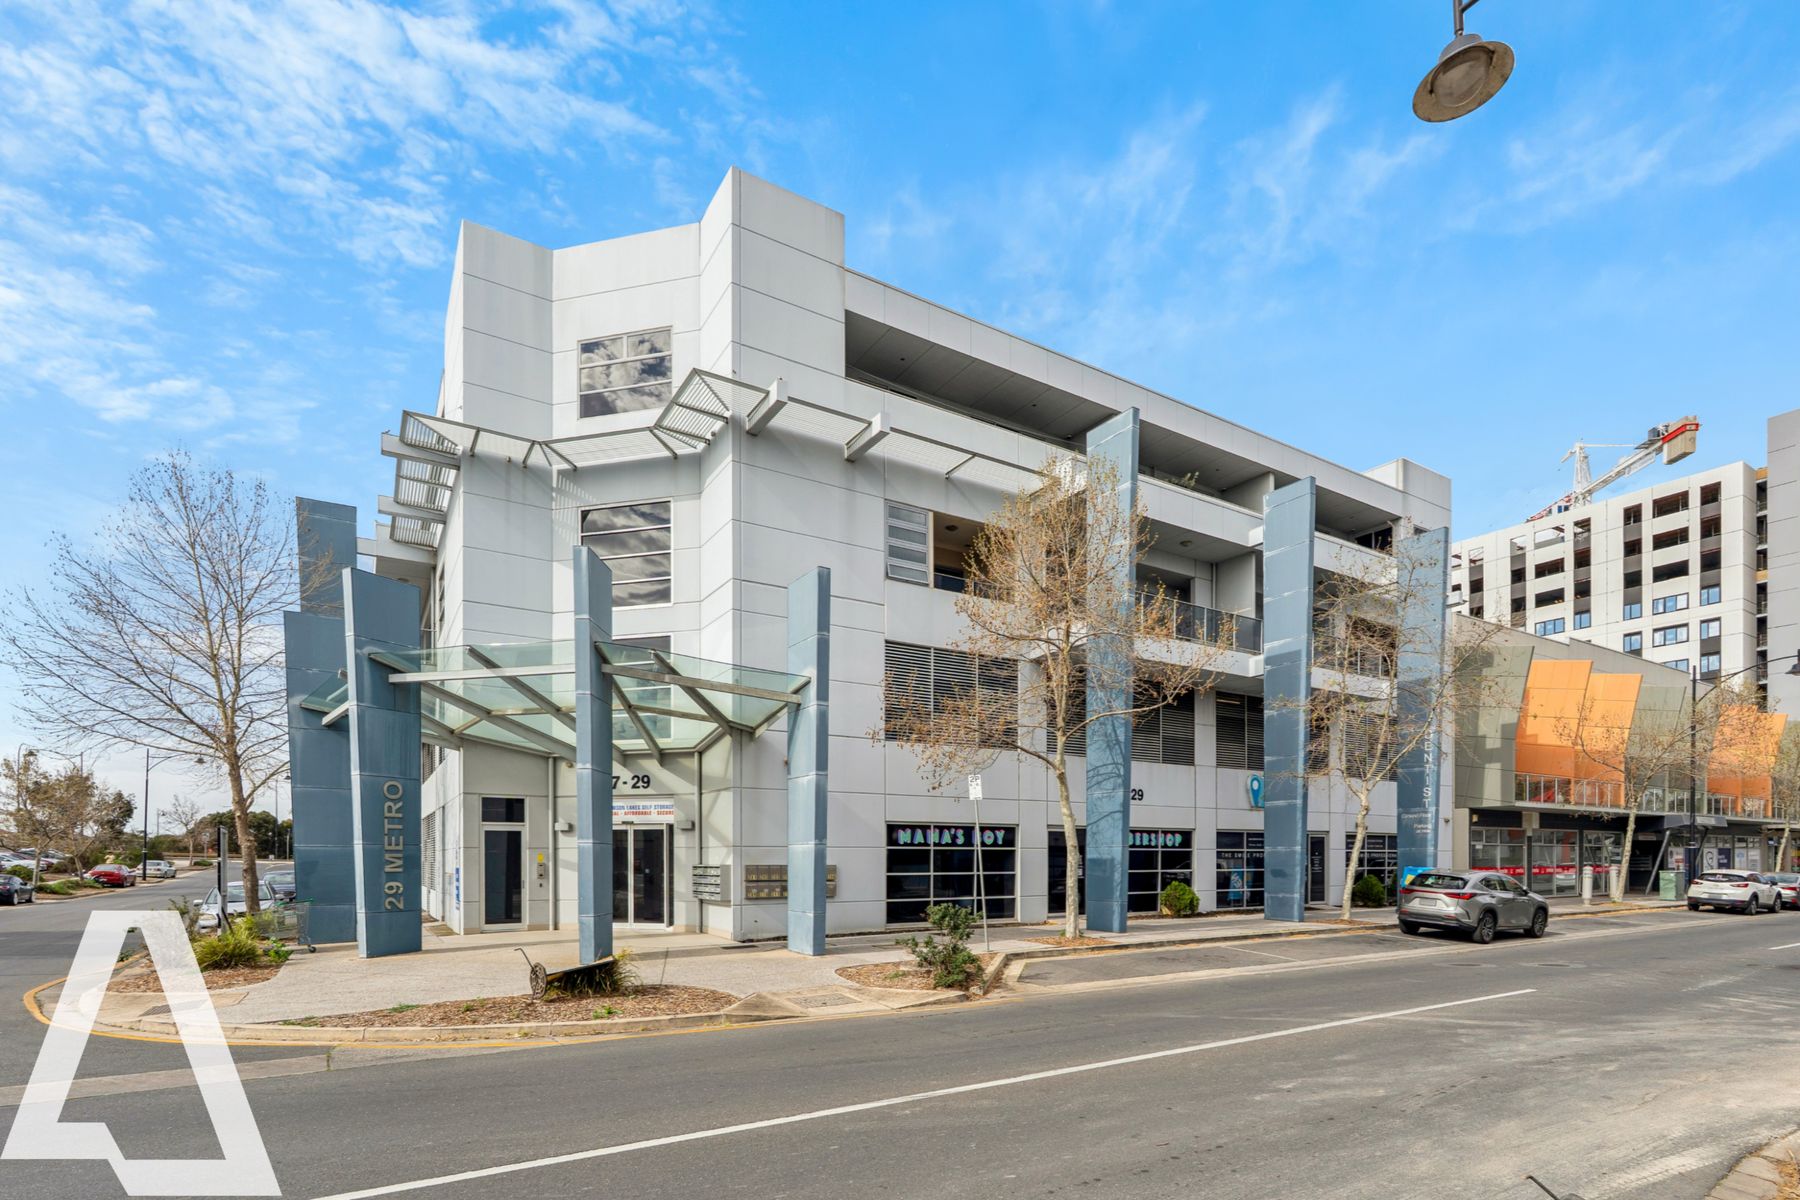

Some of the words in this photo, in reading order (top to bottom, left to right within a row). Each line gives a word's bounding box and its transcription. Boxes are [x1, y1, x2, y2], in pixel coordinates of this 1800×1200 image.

[631, 775, 651, 789] 29
[1131, 789, 1144, 801] 29
[383, 780, 404, 873] METRO
[384, 881, 404, 911] 29
